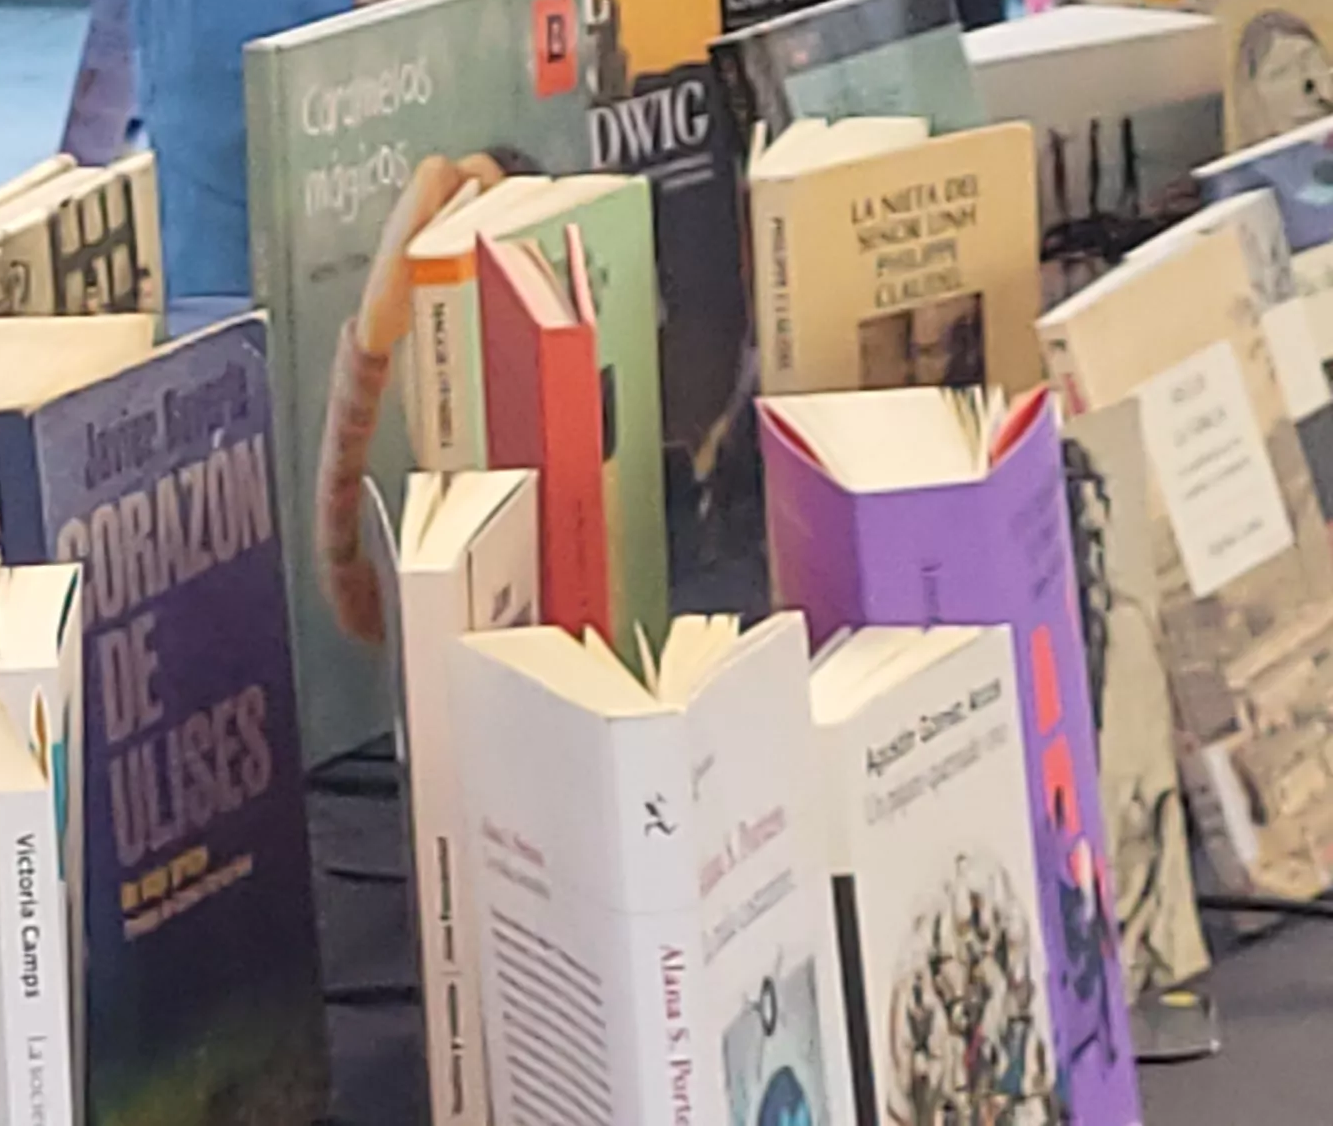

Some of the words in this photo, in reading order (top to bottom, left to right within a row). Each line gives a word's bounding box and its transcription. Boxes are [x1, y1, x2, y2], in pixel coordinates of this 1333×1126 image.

[588, 80, 710, 170] DWIG
[55, 426, 272, 630] CORAZÓN
[97, 611, 165, 745] DE
[109, 682, 272, 867] ULISES
[16, 833, 39, 920] Victoria
[21, 924, 41, 999] Camps
[659, 943, 685, 1021] Alana
